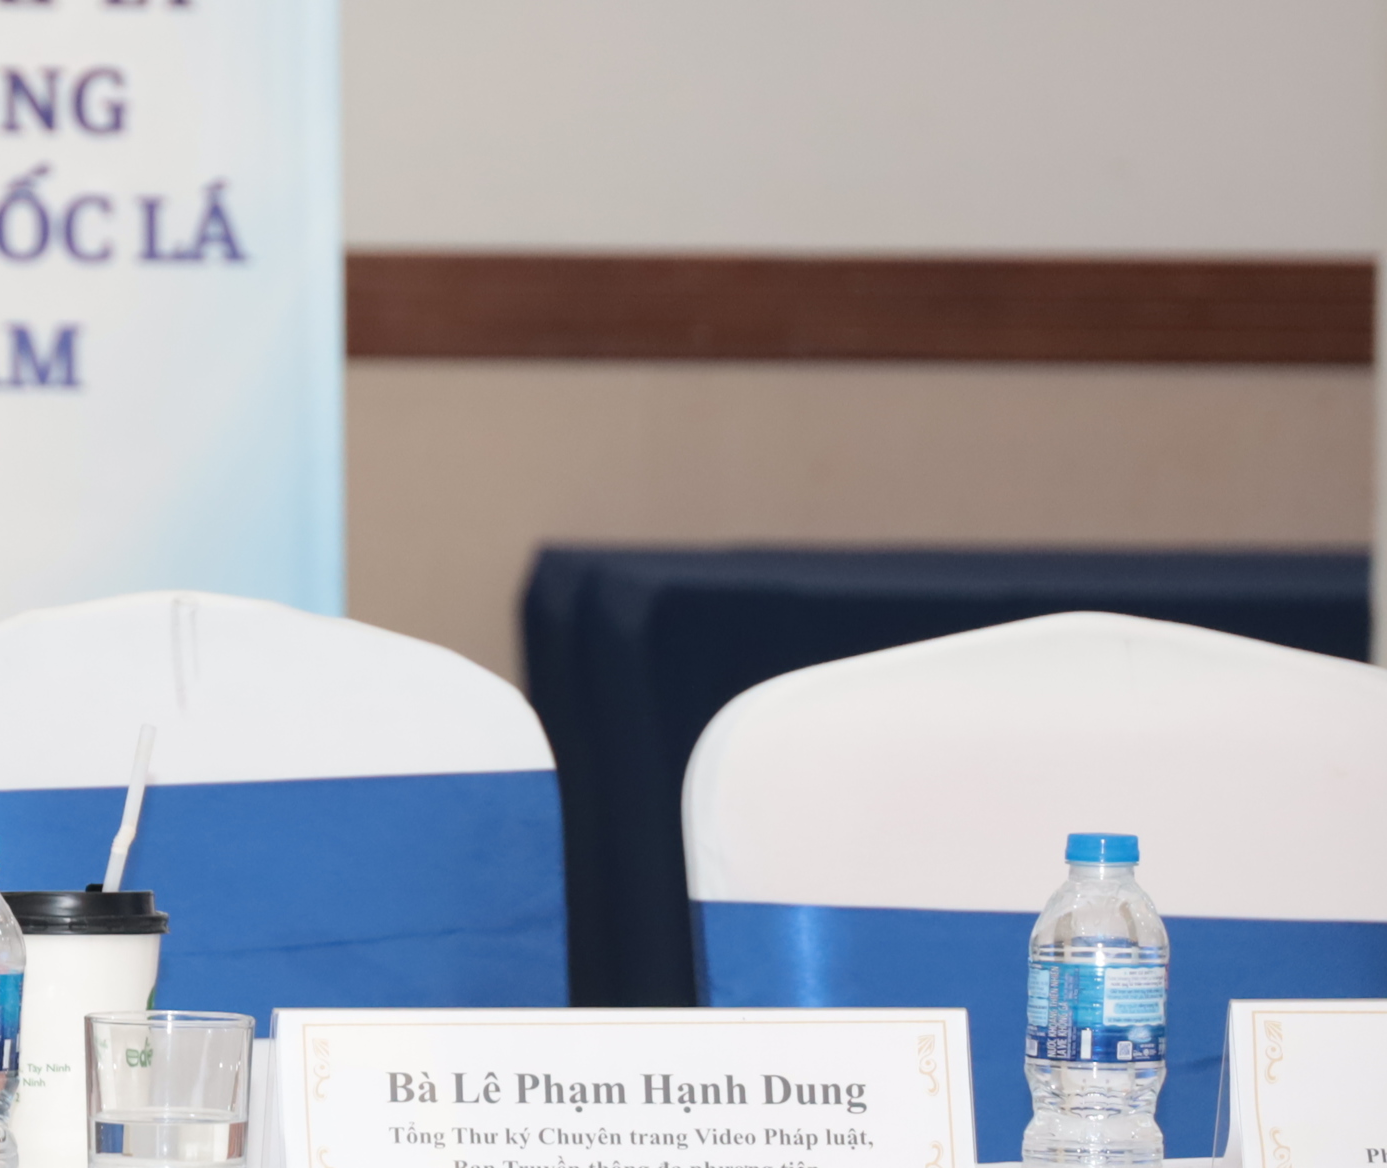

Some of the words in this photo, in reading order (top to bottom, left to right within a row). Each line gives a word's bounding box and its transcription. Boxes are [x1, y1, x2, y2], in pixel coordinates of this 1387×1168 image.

[138, 179, 249, 263] LÁ
[23, 1078, 46, 1087] Ninh
[46, 1063, 71, 1073] Ninh
[385, 1071, 438, 1104] Bà
[451, 1071, 501, 1104] Lê
[514, 1073, 628, 1113] Phạm
[640, 1073, 748, 1114] Hạnh
[760, 1074, 868, 1115] Dung
[388, 1121, 446, 1149] Tổng
[451, 1127, 499, 1145] Thư
[505, 1127, 530, 1150] ký
[538, 1127, 622, 1150] Chuyên
[630, 1129, 688, 1150] trang
[694, 1128, 756, 1146] Video
[764, 1128, 818, 1150] Pháp
[826, 1128, 874, 1150] luật,
